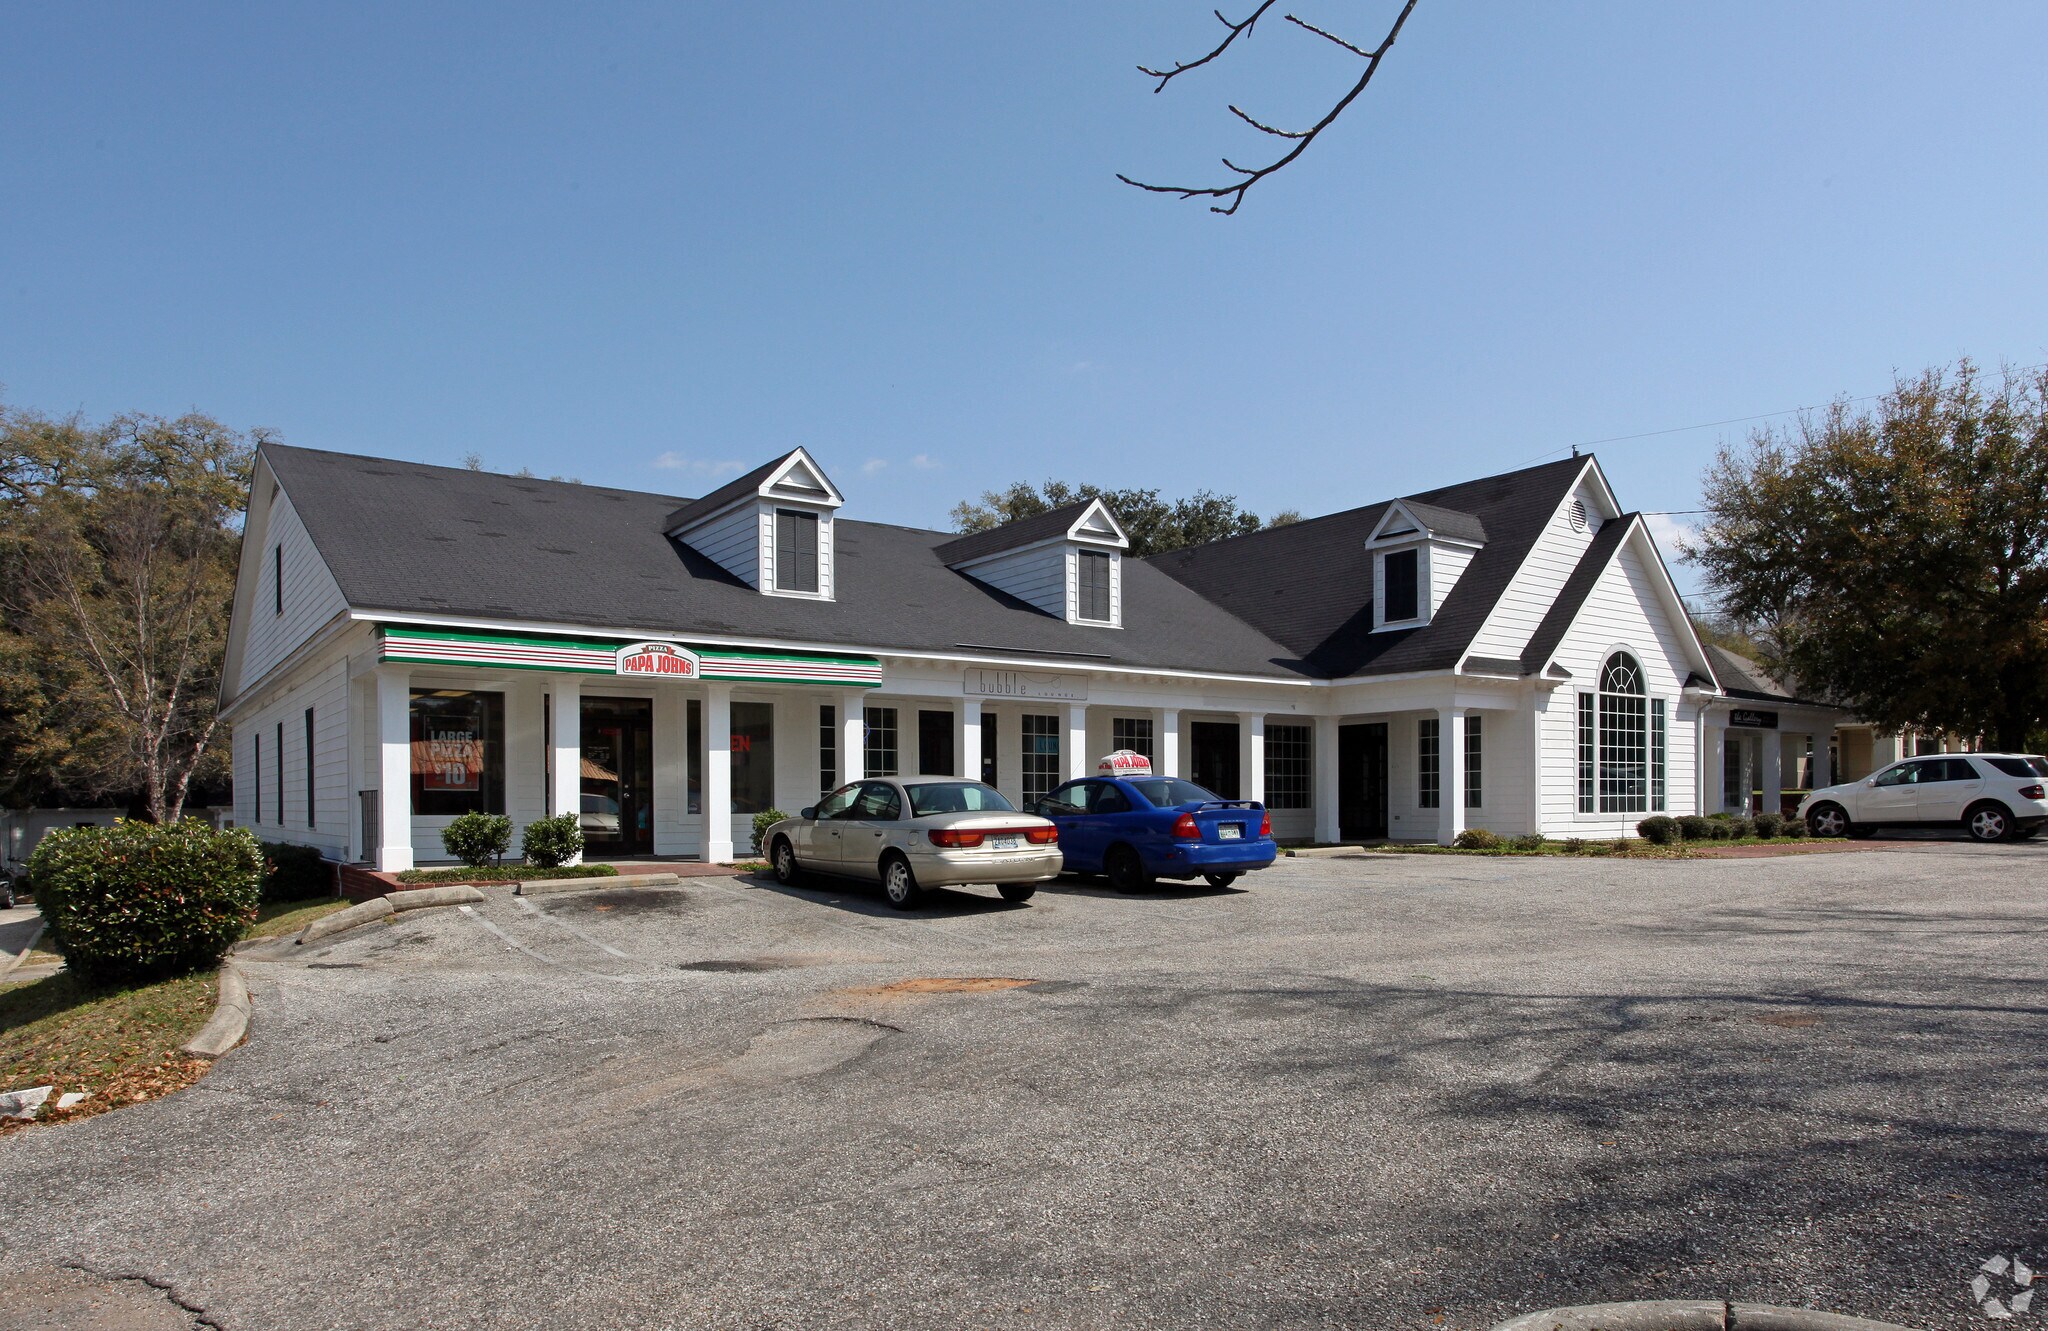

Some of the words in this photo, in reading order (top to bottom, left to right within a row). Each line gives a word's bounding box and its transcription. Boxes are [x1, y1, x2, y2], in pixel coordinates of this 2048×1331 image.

[625, 655, 654, 672] PAPA
[656, 655, 692, 674] JOHNS
[980, 671, 1026, 695] bubble
[430, 730, 473, 743] LARGE
[730, 735, 751, 752] EN
[431, 742, 474, 759] PIZZA
[1113, 756, 1130, 768] PAPA
